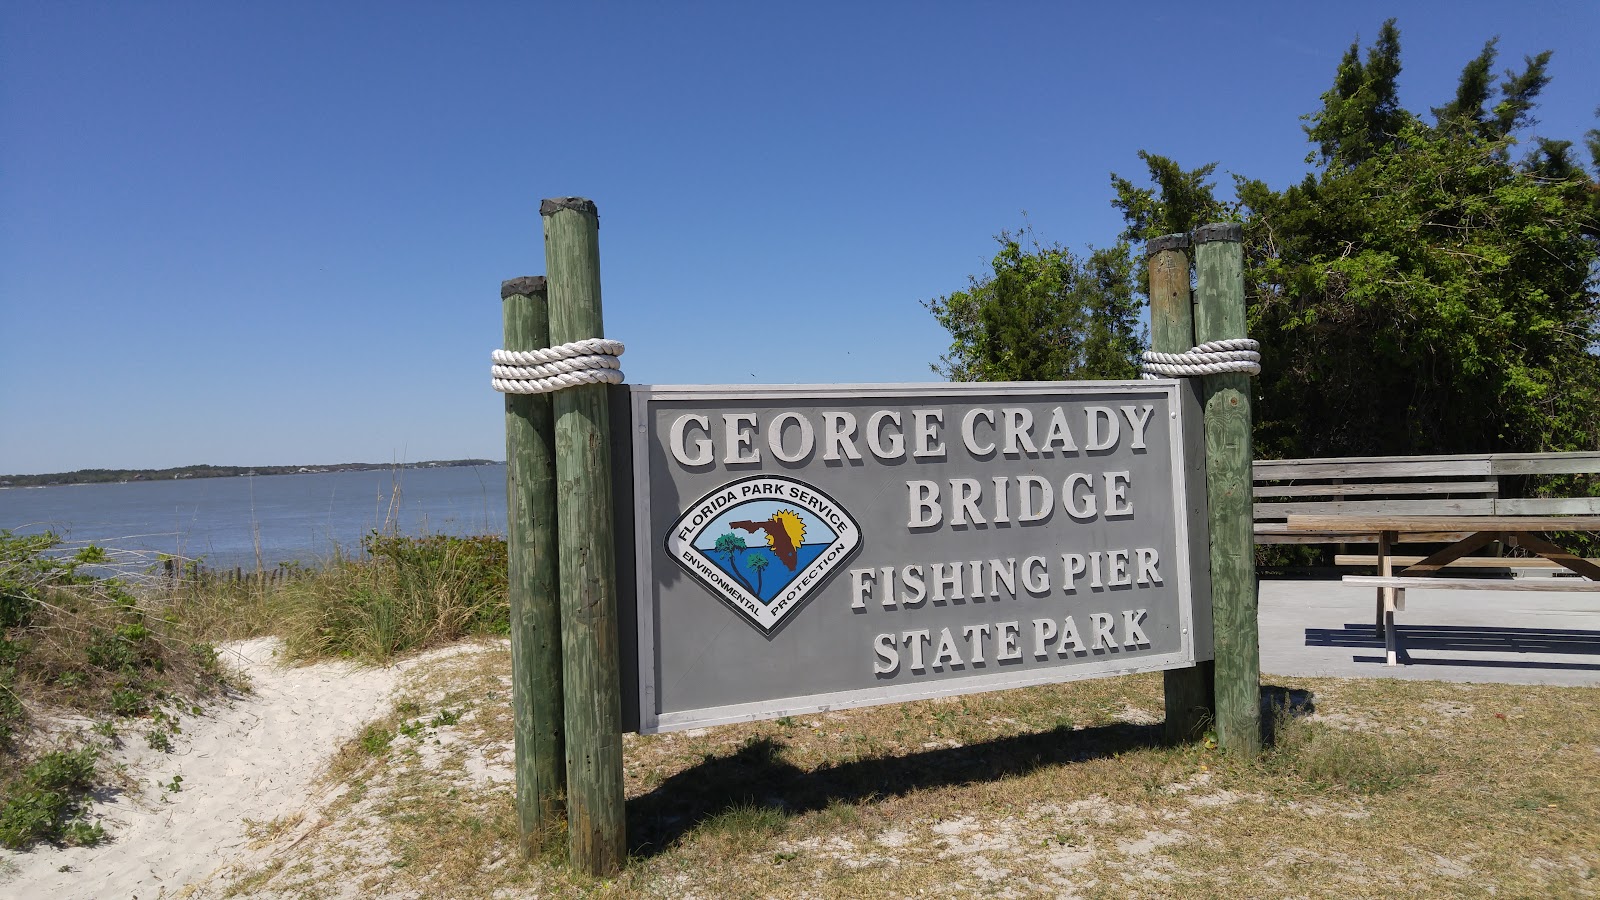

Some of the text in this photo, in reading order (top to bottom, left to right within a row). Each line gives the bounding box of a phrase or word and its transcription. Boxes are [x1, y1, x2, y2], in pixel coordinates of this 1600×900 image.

[669, 404, 1153, 466] GEORGE CRADY
[678, 483, 849, 542] FLORIDA PARK SERVICE
[906, 470, 1135, 528] BRIDGE
[682, 543, 846, 617] ENVIRONMENTAL PROTECTION
[849, 547, 1163, 609] FISHING PIER
[873, 608, 1151, 674] STATE PARK
